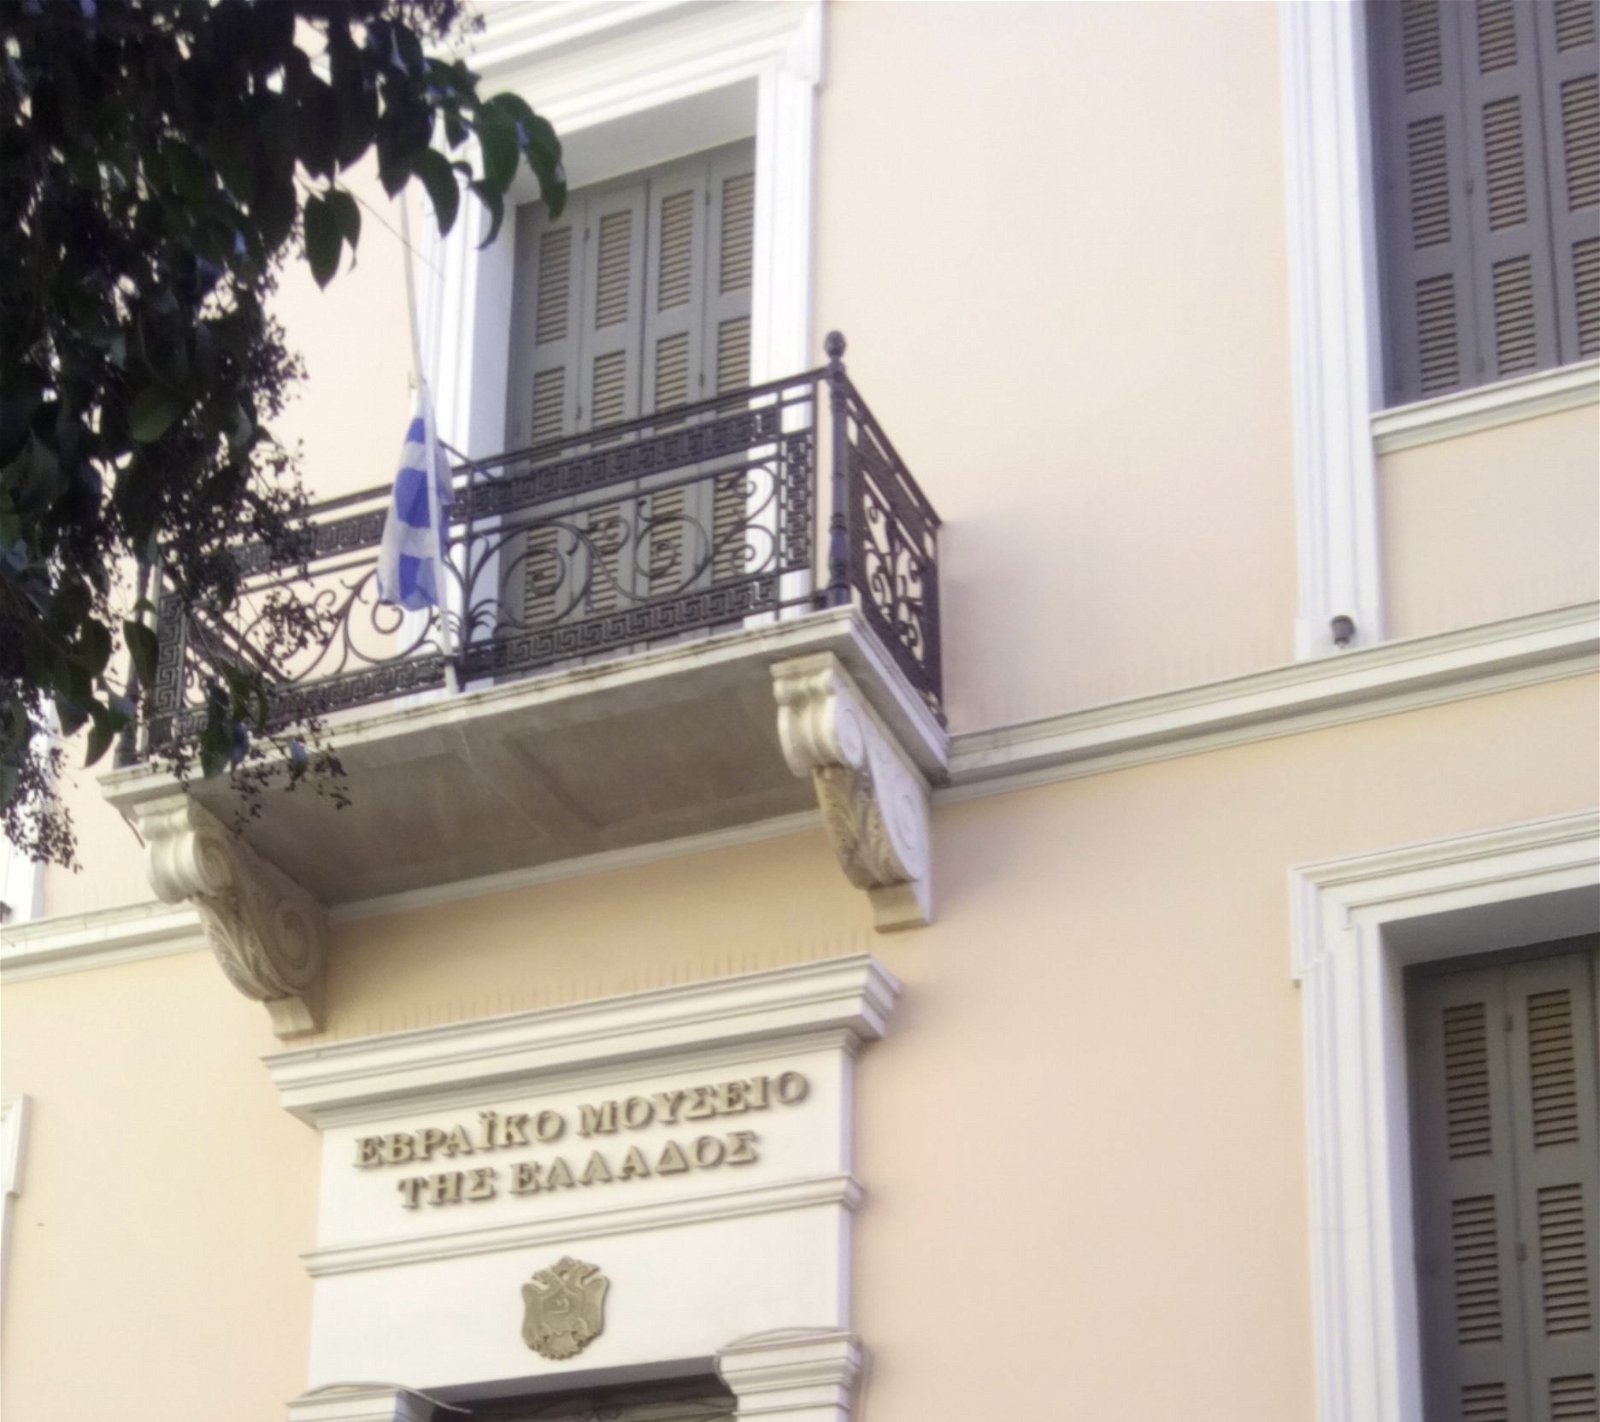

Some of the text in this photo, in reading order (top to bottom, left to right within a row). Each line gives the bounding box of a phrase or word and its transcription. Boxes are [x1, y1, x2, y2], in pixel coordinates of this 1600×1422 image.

[354, 1071, 810, 1168] ΕΒΡΑΪΚΟ ΜΟΥΣΕΙΟ
[398, 1130, 760, 1209] ΤΗΣ ΕΛΛΑΔΟΣ
